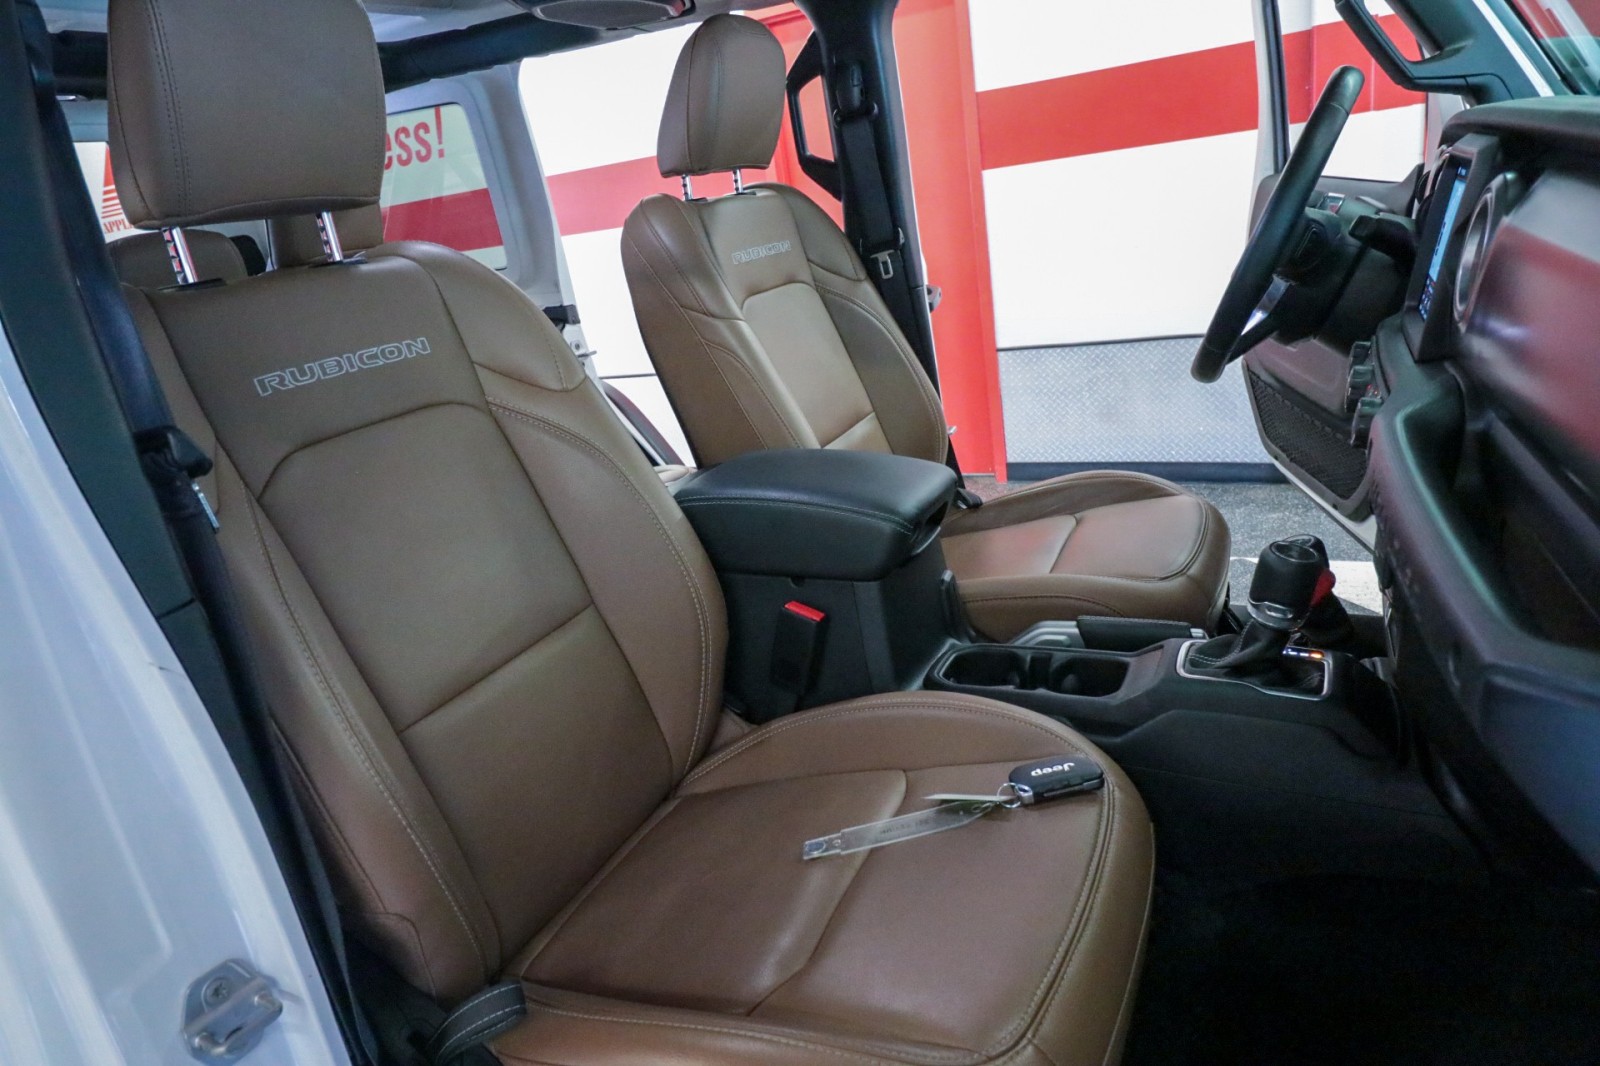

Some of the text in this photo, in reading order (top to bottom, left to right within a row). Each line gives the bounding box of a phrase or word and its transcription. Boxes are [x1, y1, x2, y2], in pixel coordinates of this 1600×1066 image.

[731, 240, 792, 265] RUBICON
[253, 337, 431, 397] RUBICON
[1030, 762, 1075, 777] Jeep
